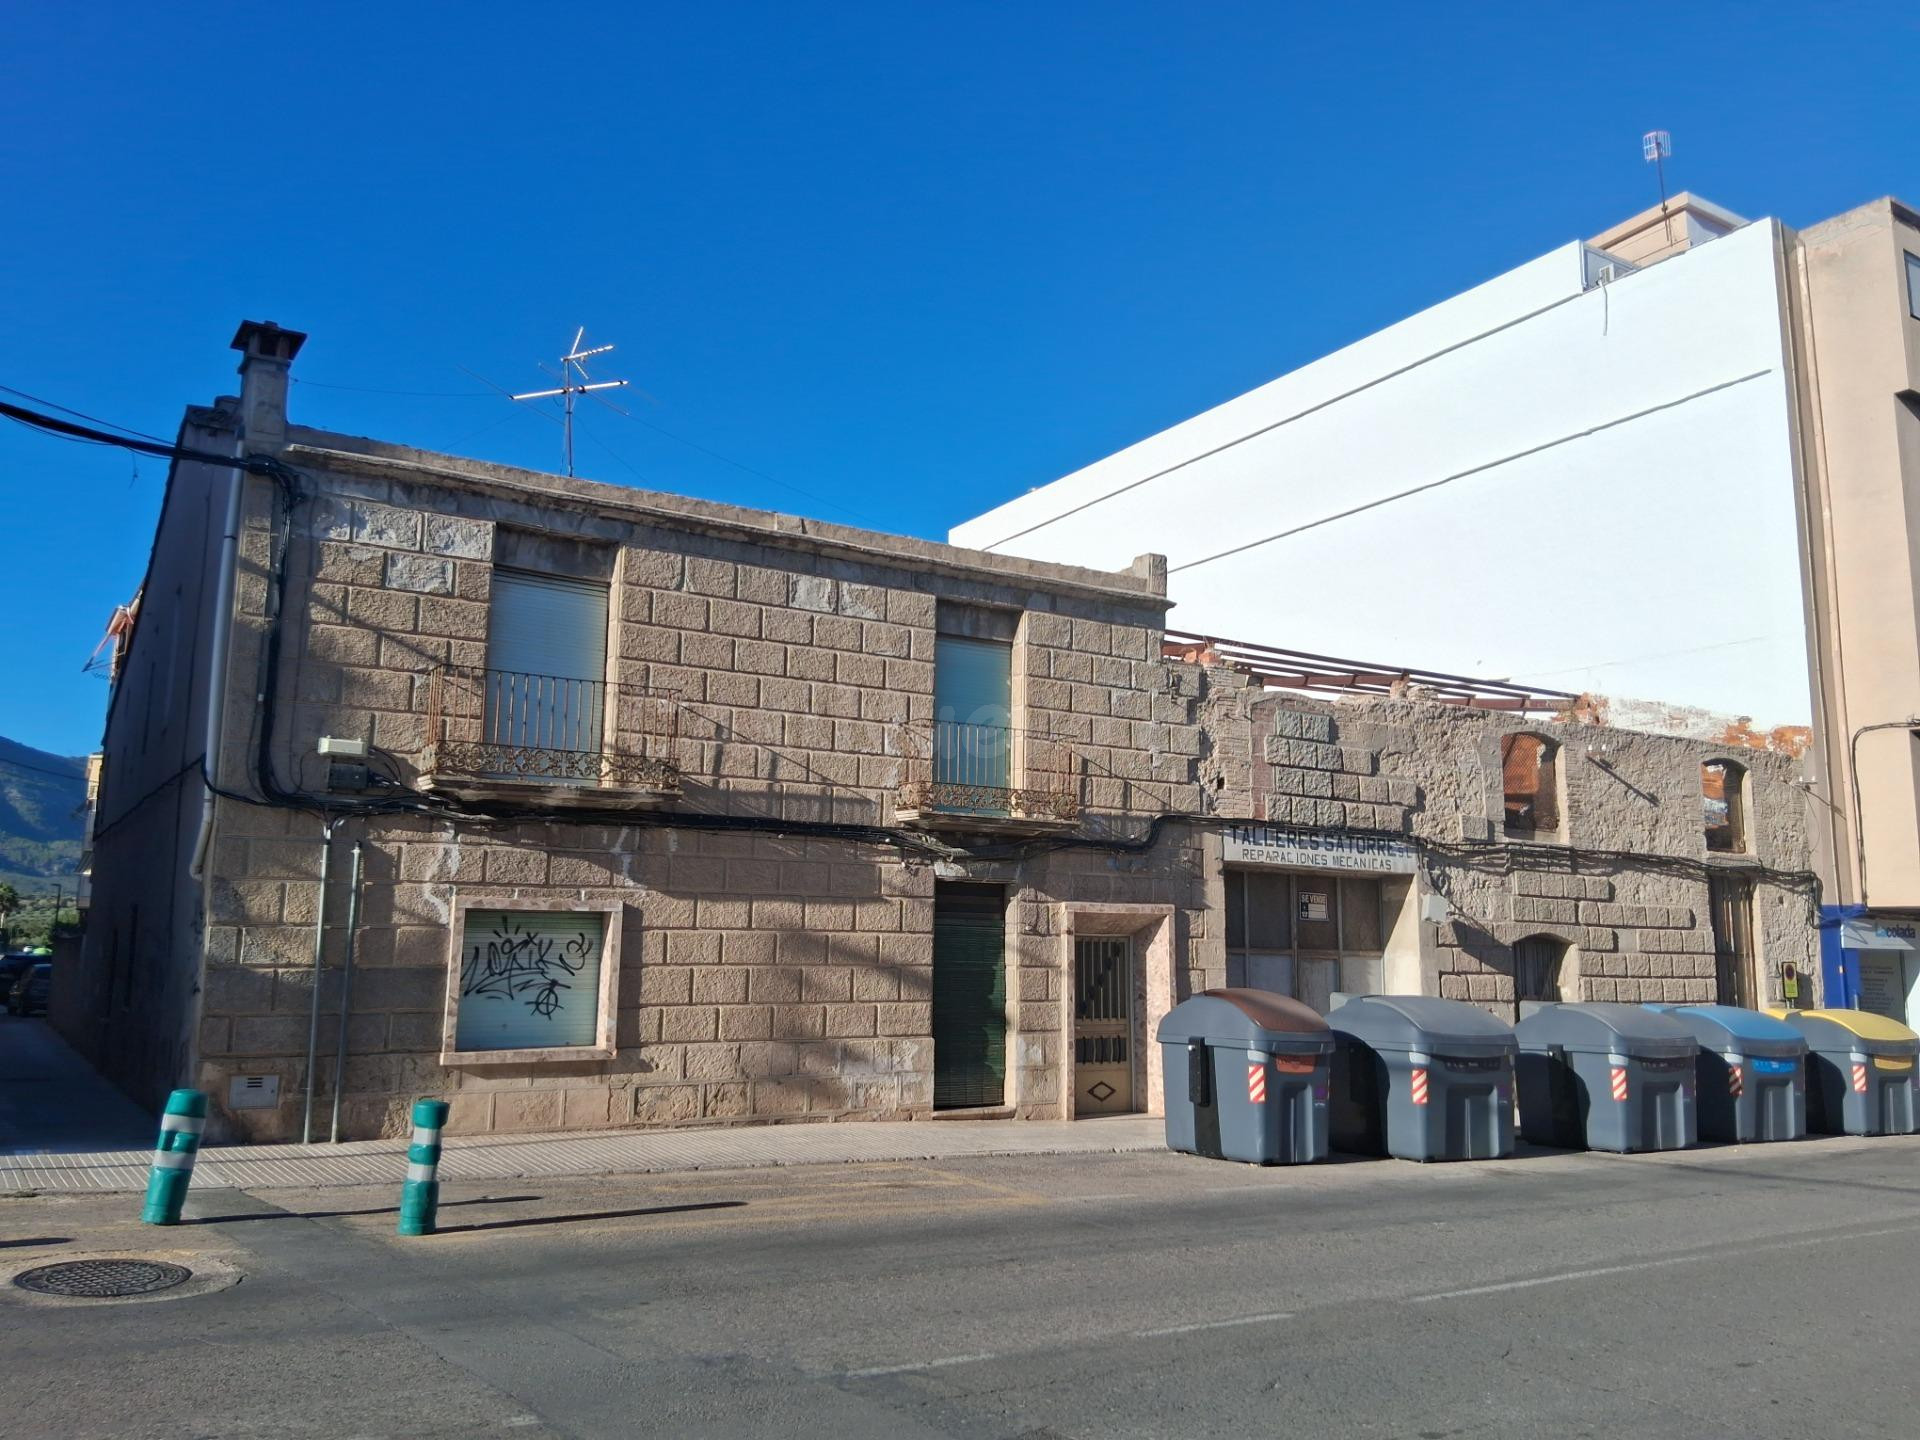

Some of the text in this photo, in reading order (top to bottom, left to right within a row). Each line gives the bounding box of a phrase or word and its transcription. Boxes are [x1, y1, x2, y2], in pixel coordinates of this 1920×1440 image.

[1229, 825, 1320, 851] TALLERES
[1324, 832, 1397, 857] SATORRE
[1242, 848, 1392, 871] REPARACIONES MECANICAS
